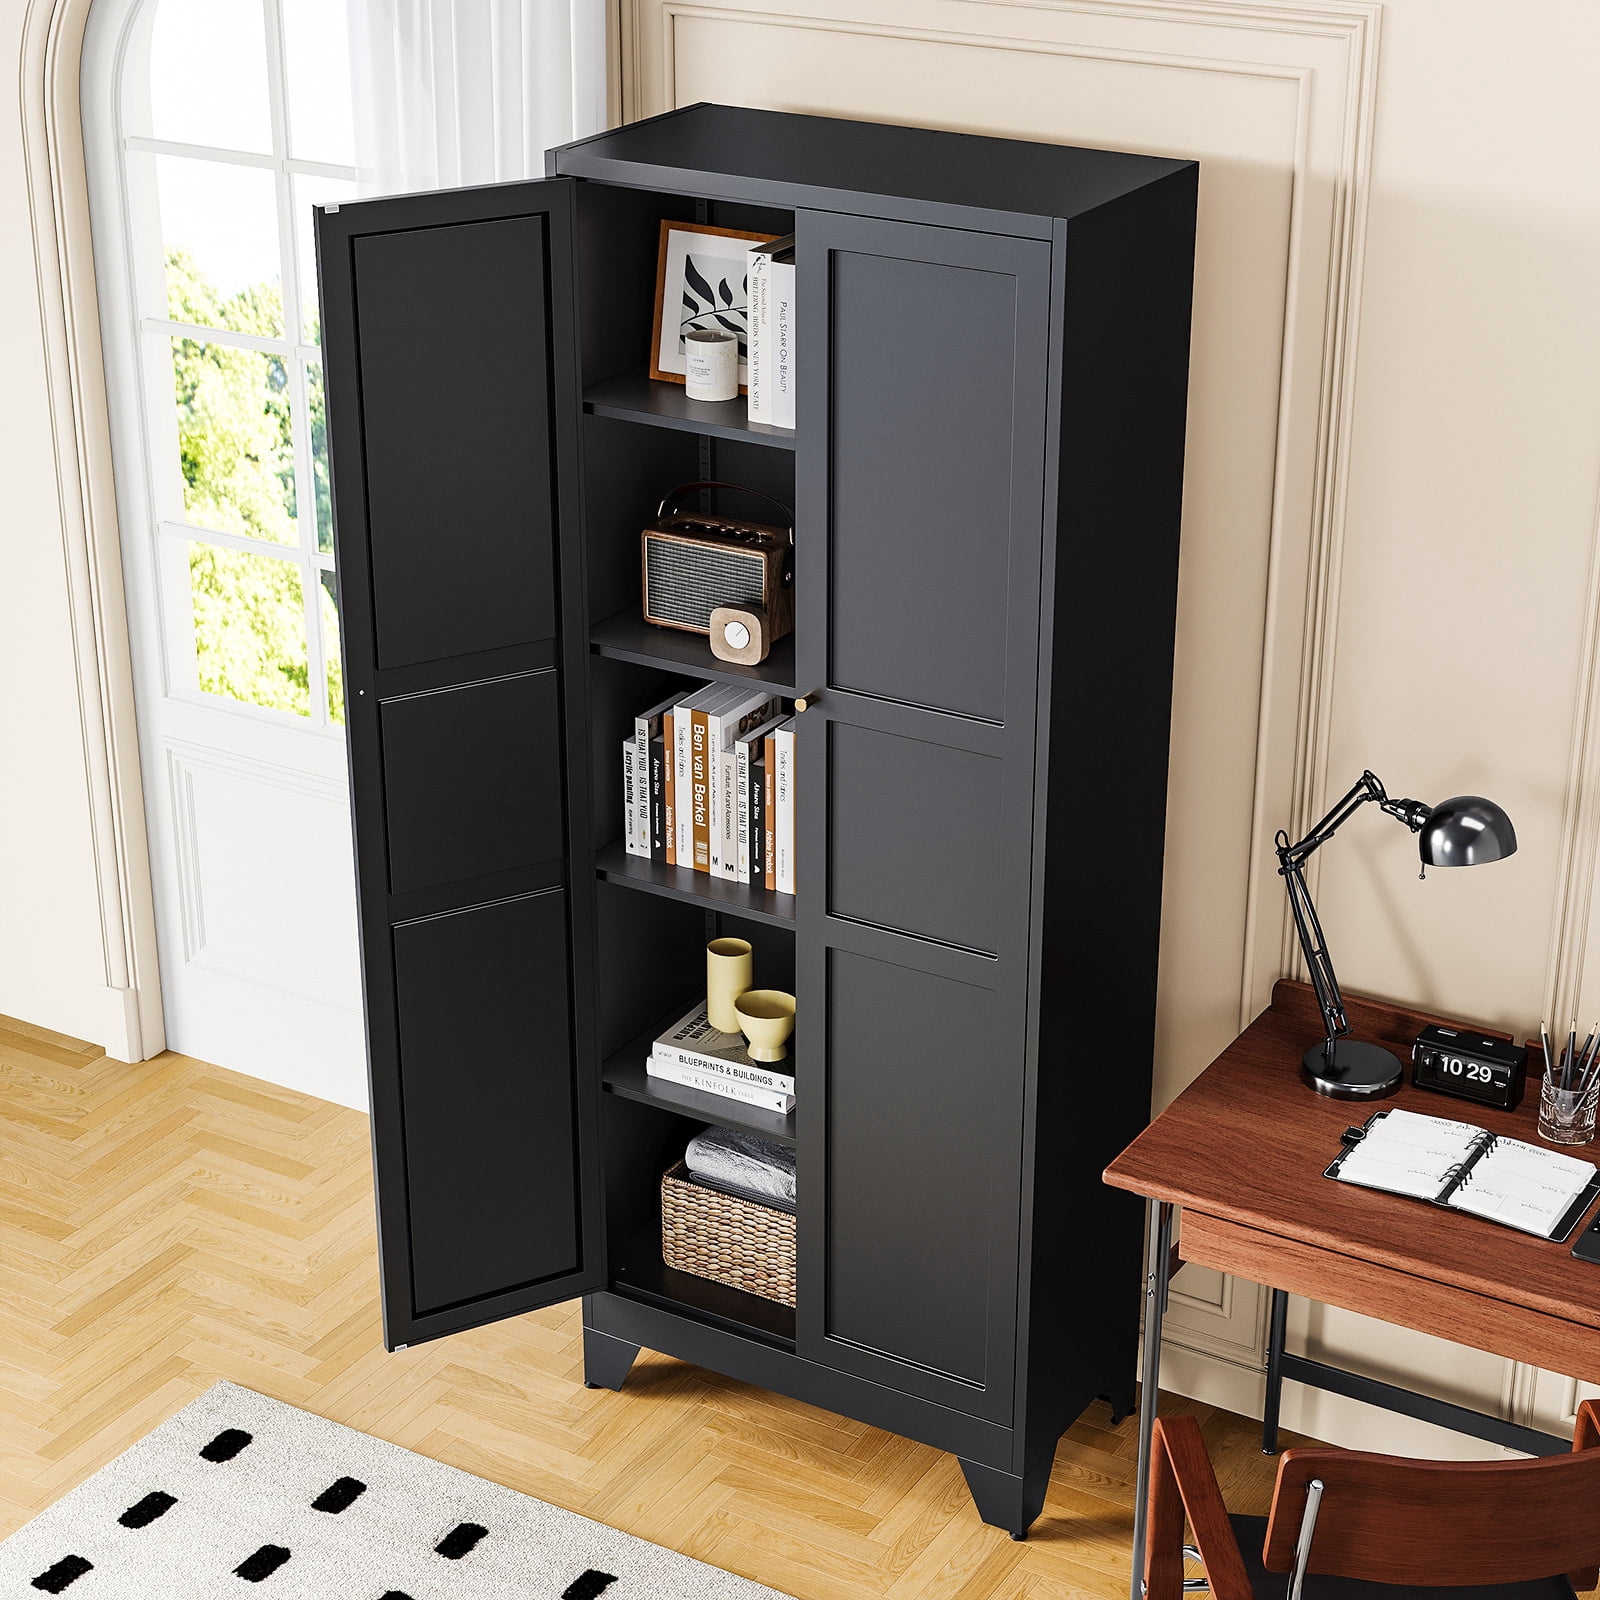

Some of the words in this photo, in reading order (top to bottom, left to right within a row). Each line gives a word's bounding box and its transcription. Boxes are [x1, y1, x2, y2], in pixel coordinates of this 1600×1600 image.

[637, 728, 646, 737] IS
[693, 724, 705, 751] Ben
[638, 738, 646, 755] THAT
[739, 752, 745, 760] IS
[625, 751, 634, 774] Acrylic
[694, 755, 703, 781] van
[626, 775, 634, 804] painting
[694, 783, 706, 826] Berkel
[713, 856, 718, 865] M
[725, 863, 734, 872] M
[673, 1011, 708, 1040] BLUEPRINT
[678, 1055, 724, 1073] BLUEPRINTS
[726, 1067, 732, 1075] &
[733, 1069, 773, 1086] BUILDINGS
[1441, 1056, 1463, 1076] 10
[1466, 1062, 1492, 1083] 29
[694, 1077, 736, 1096] KINFOLK
